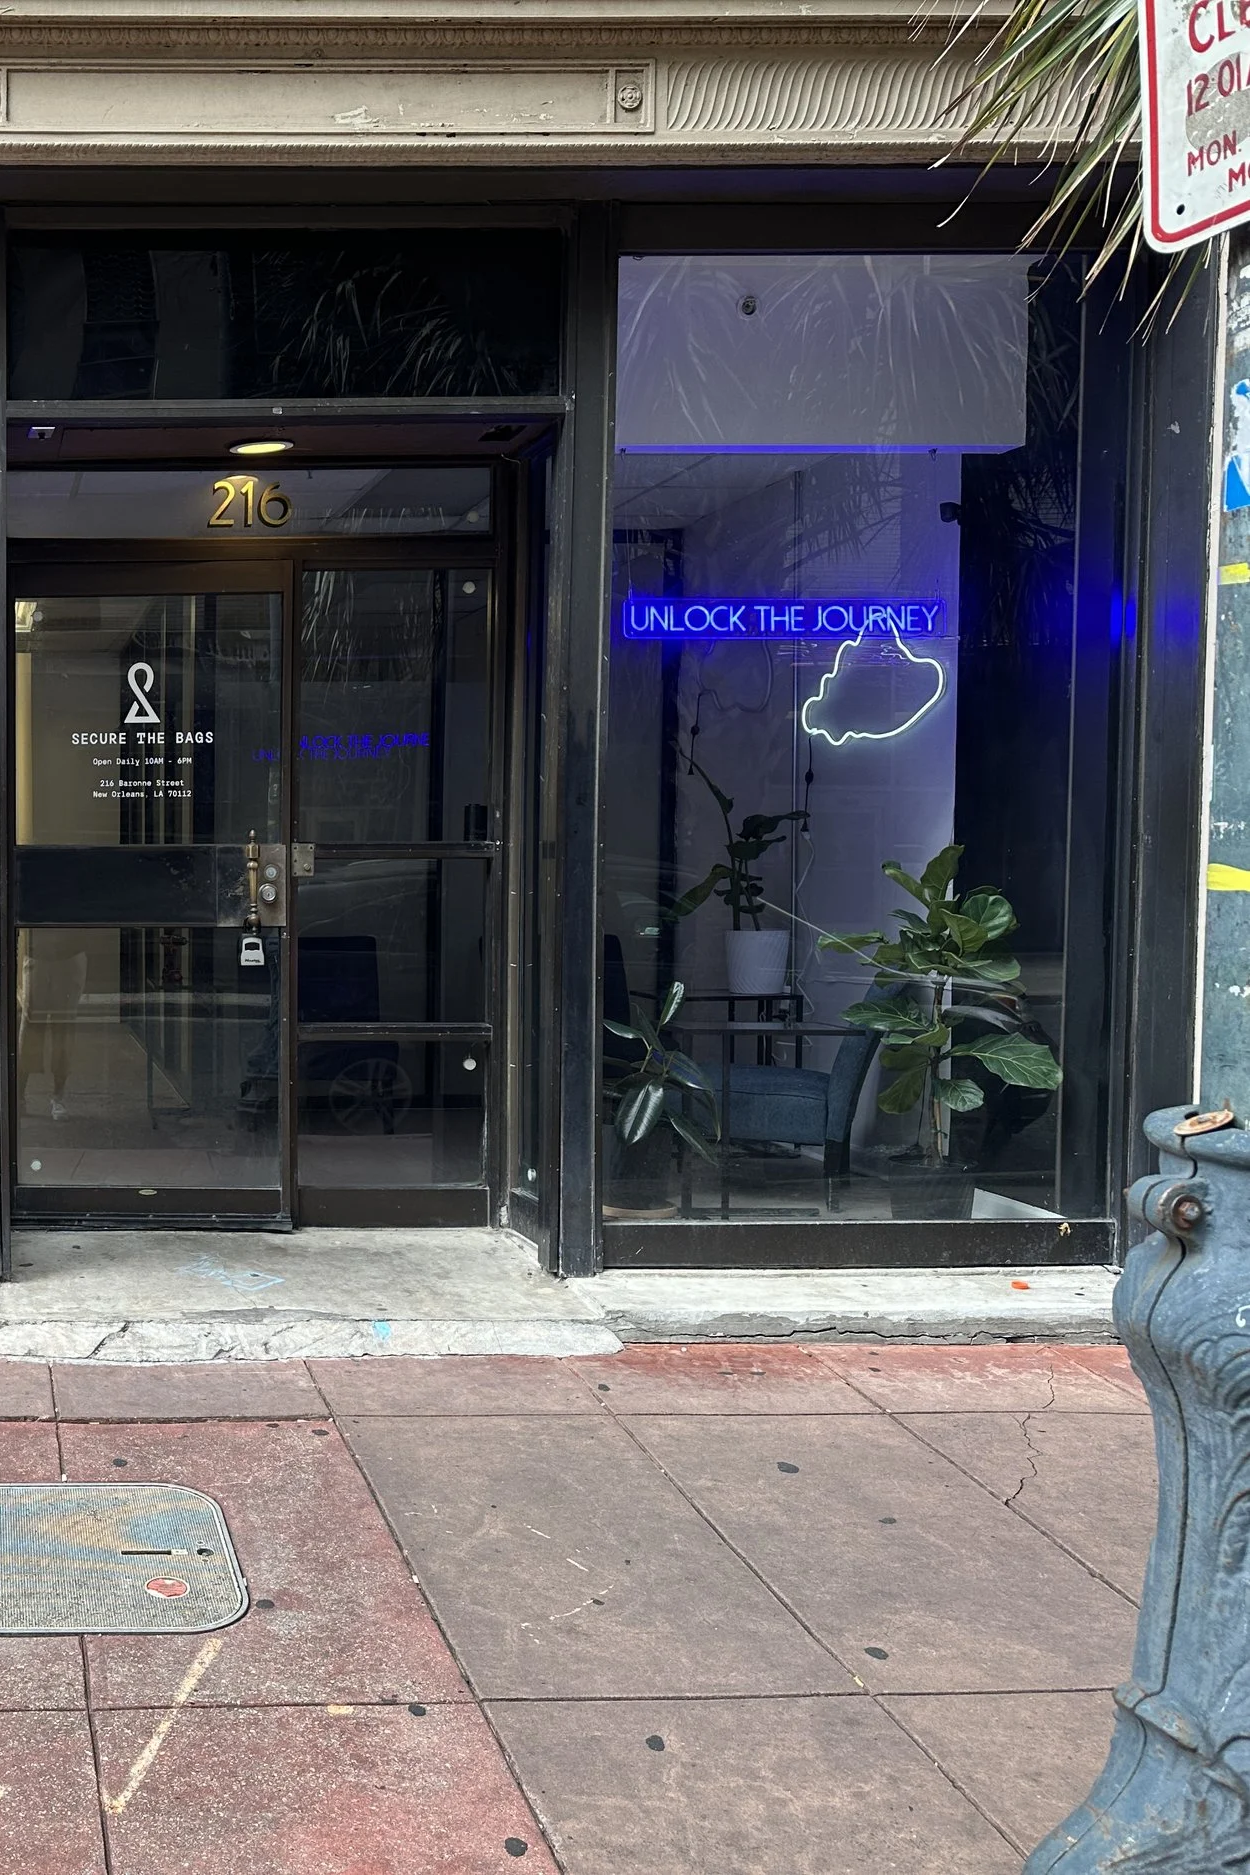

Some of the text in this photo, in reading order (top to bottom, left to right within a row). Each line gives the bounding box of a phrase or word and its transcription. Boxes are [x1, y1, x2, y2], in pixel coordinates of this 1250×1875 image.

[209, 480, 293, 528] 216
[630, 605, 939, 632] UNLOCK THE JOURNEY
[71, 731, 214, 745] SECURE THE BAGS
[92, 758, 112, 767] Open
[116, 757, 140, 767] Daily
[145, 757, 164, 765] 10AM
[177, 757, 192, 765] 6PM
[156, 779, 184, 787] Street
[111, 790, 149, 799] Orleans,
[168, 790, 192, 798] 70112
